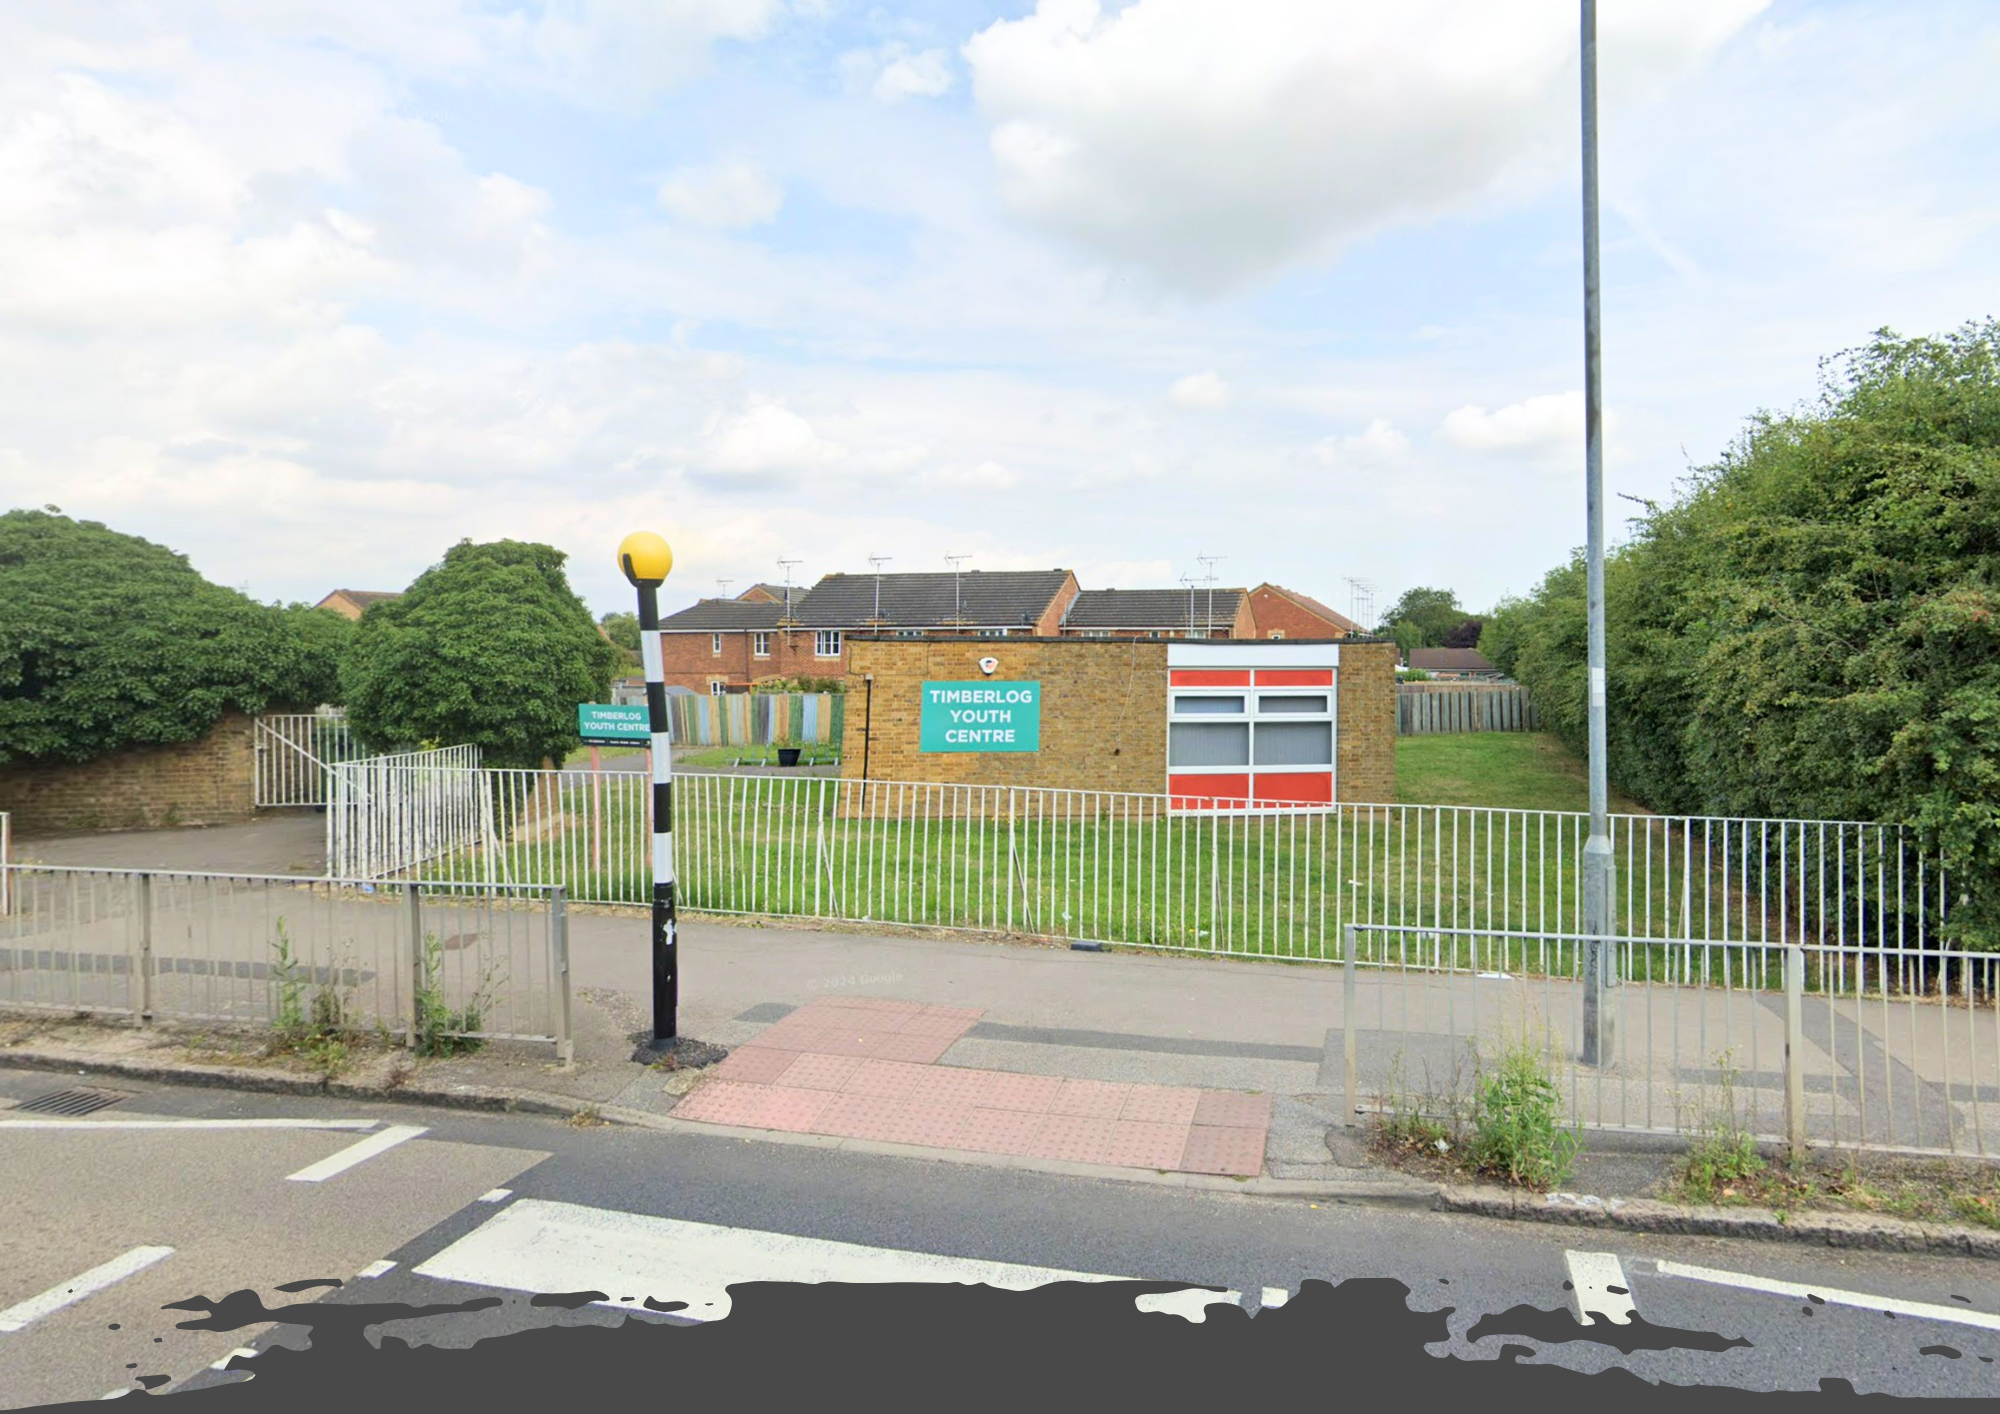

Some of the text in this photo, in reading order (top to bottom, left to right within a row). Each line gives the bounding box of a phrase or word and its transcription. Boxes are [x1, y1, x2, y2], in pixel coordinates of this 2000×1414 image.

[930, 690, 1033, 703] TIMBERLOG
[591, 711, 641, 720] TIMBERLOG
[950, 710, 1011, 723] YOUTH
[584, 721, 650, 731] YOUTH CENTRE
[945, 729, 1015, 743] CENTRE
